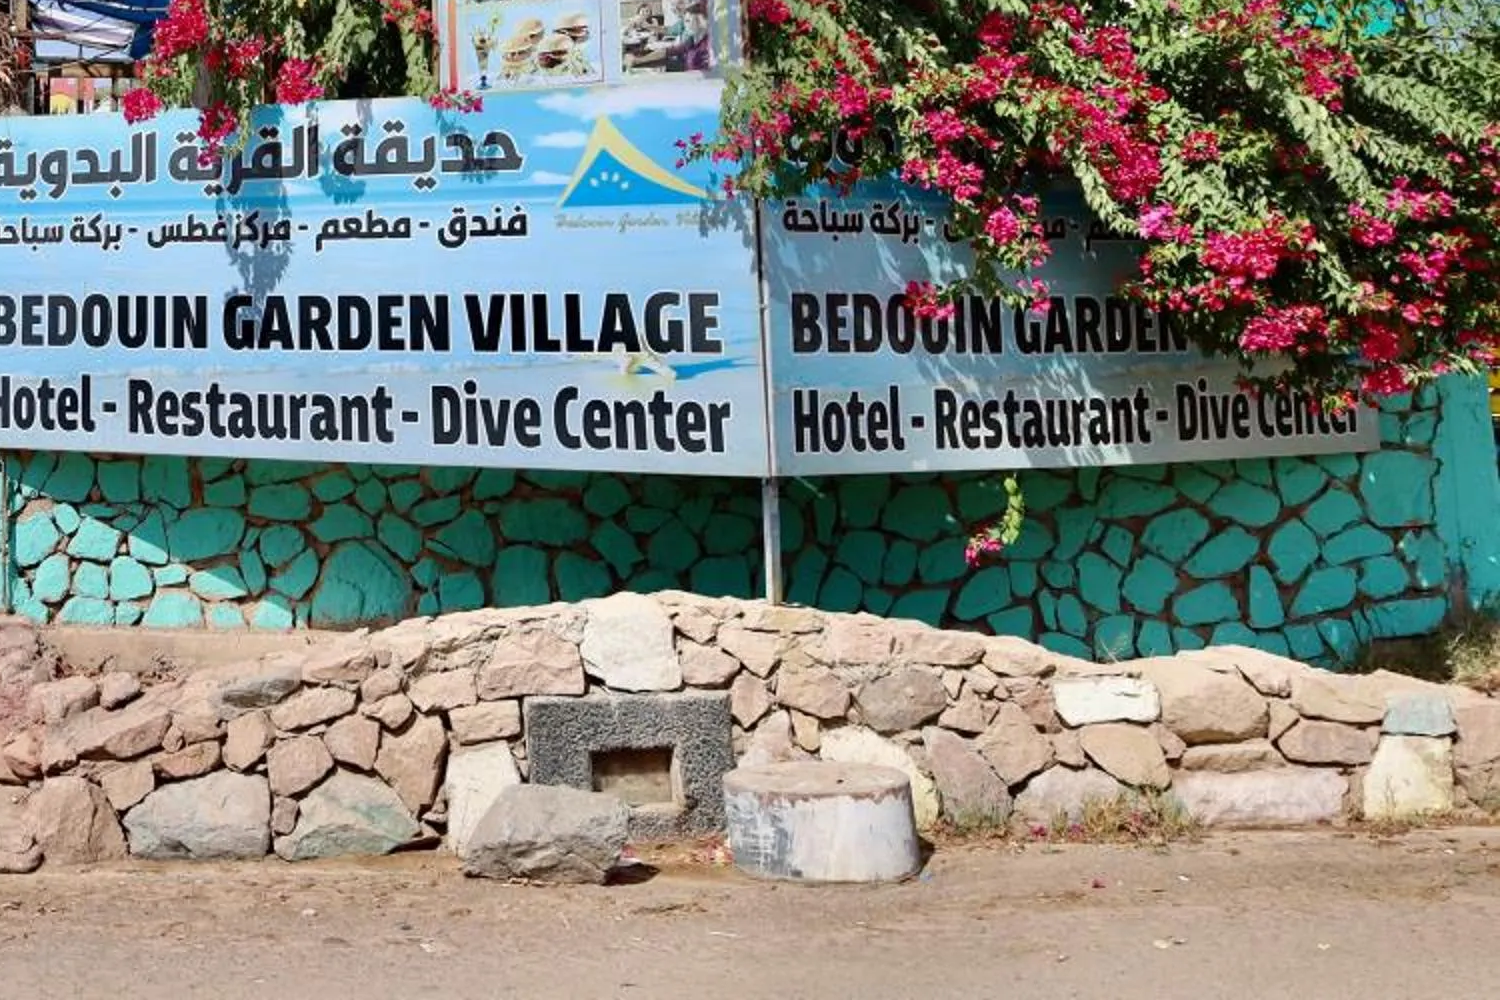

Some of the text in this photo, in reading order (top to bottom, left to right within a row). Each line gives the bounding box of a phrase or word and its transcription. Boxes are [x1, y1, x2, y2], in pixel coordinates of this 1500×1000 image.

[168, 123, 320, 196] القرية
[333, 119, 524, 190] حديقة
[69, 212, 122, 250] بركة
[315, 209, 411, 252] مطعم
[437, 204, 528, 249] فندق
[783, 200, 864, 241] سباحة
[869, 203, 920, 244] بركة
[223, 294, 450, 351] GARDEN
[464, 291, 723, 353] VILLAGE
[792, 292, 1002, 354] BEDOUIN
[128, 379, 395, 444] Restaurant
[431, 379, 542, 447] Dive
[553, 385, 731, 453] Center
[793, 385, 905, 454] Hotel
[934, 386, 1152, 451] Restaurant
[1176, 378, 1250, 442] Dive
